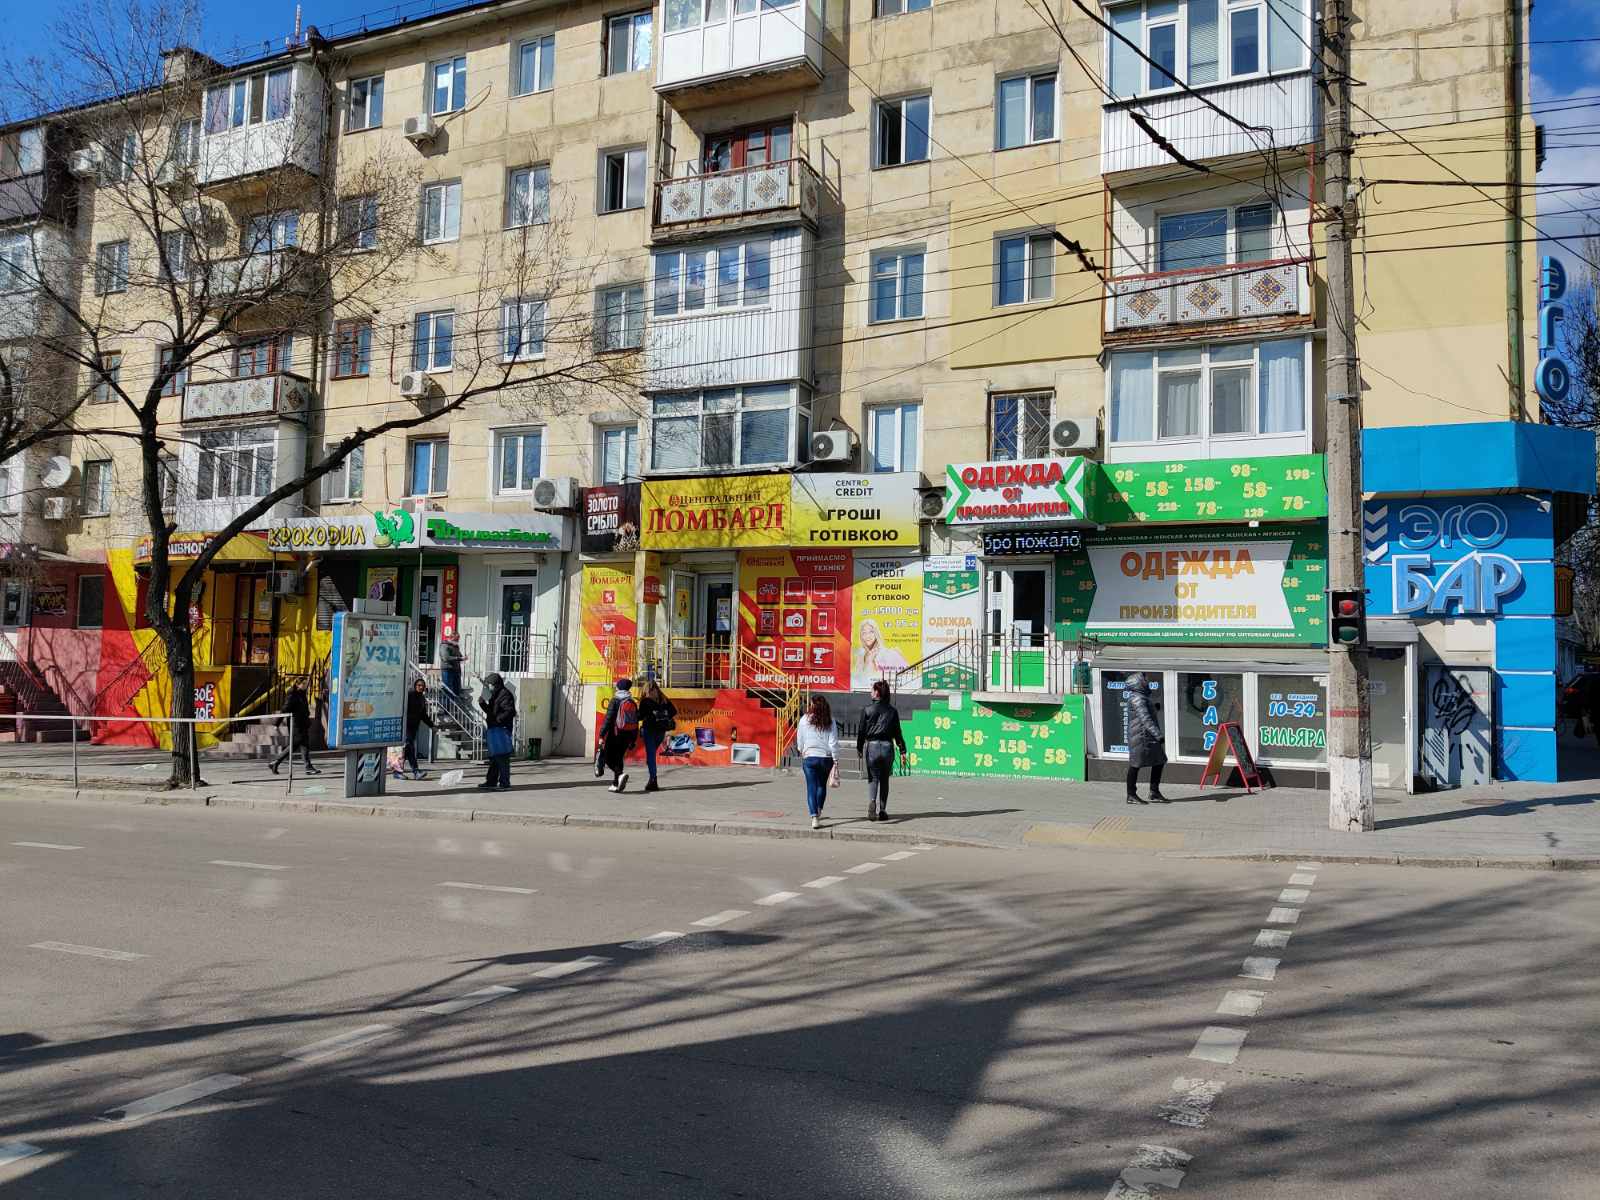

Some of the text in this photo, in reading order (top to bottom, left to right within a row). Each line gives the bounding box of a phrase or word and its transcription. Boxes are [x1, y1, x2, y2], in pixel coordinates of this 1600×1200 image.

[1534, 255, 1570, 402] ЭГО
[836, 479, 870, 487] CENTRO
[961, 463, 1065, 491] ОДЕЖДА
[835, 487, 874, 497] CREDIT
[1002, 488, 1023, 502] ОТ
[587, 496, 619, 512] ЗОЛОТО
[956, 502, 1071, 519] ПРОИЗВОДИТЕЛЯ
[587, 513, 619, 530] СРІБЛО
[646, 503, 784, 534] ЛОМБАРД
[827, 508, 880, 521] ГРОШІ
[1399, 503, 1509, 549] ЭГО
[267, 525, 366, 547] КРОКОДИЛ
[810, 529, 898, 542] ГОТІВКОЮ
[1015, 535, 1081, 549] пожало
[870, 561, 900, 569] CENTRO
[870, 569, 905, 578] CREDIT
[1120, 549, 1255, 581] ОДЕЖДА
[875, 583, 902, 591] ГРОШІ
[1174, 581, 1199, 599] ОТ
[1391, 551, 1523, 614] БАР
[1119, 604, 1257, 621] ПРОИЗВОДИТЕЛЯ
[928, 616, 972, 628] ОДЕЖДА
[1202, 681, 1219, 751] БАР
[1268, 701, 1316, 718] 10-24
[1259, 726, 1326, 748] БИЛЬЯРД
